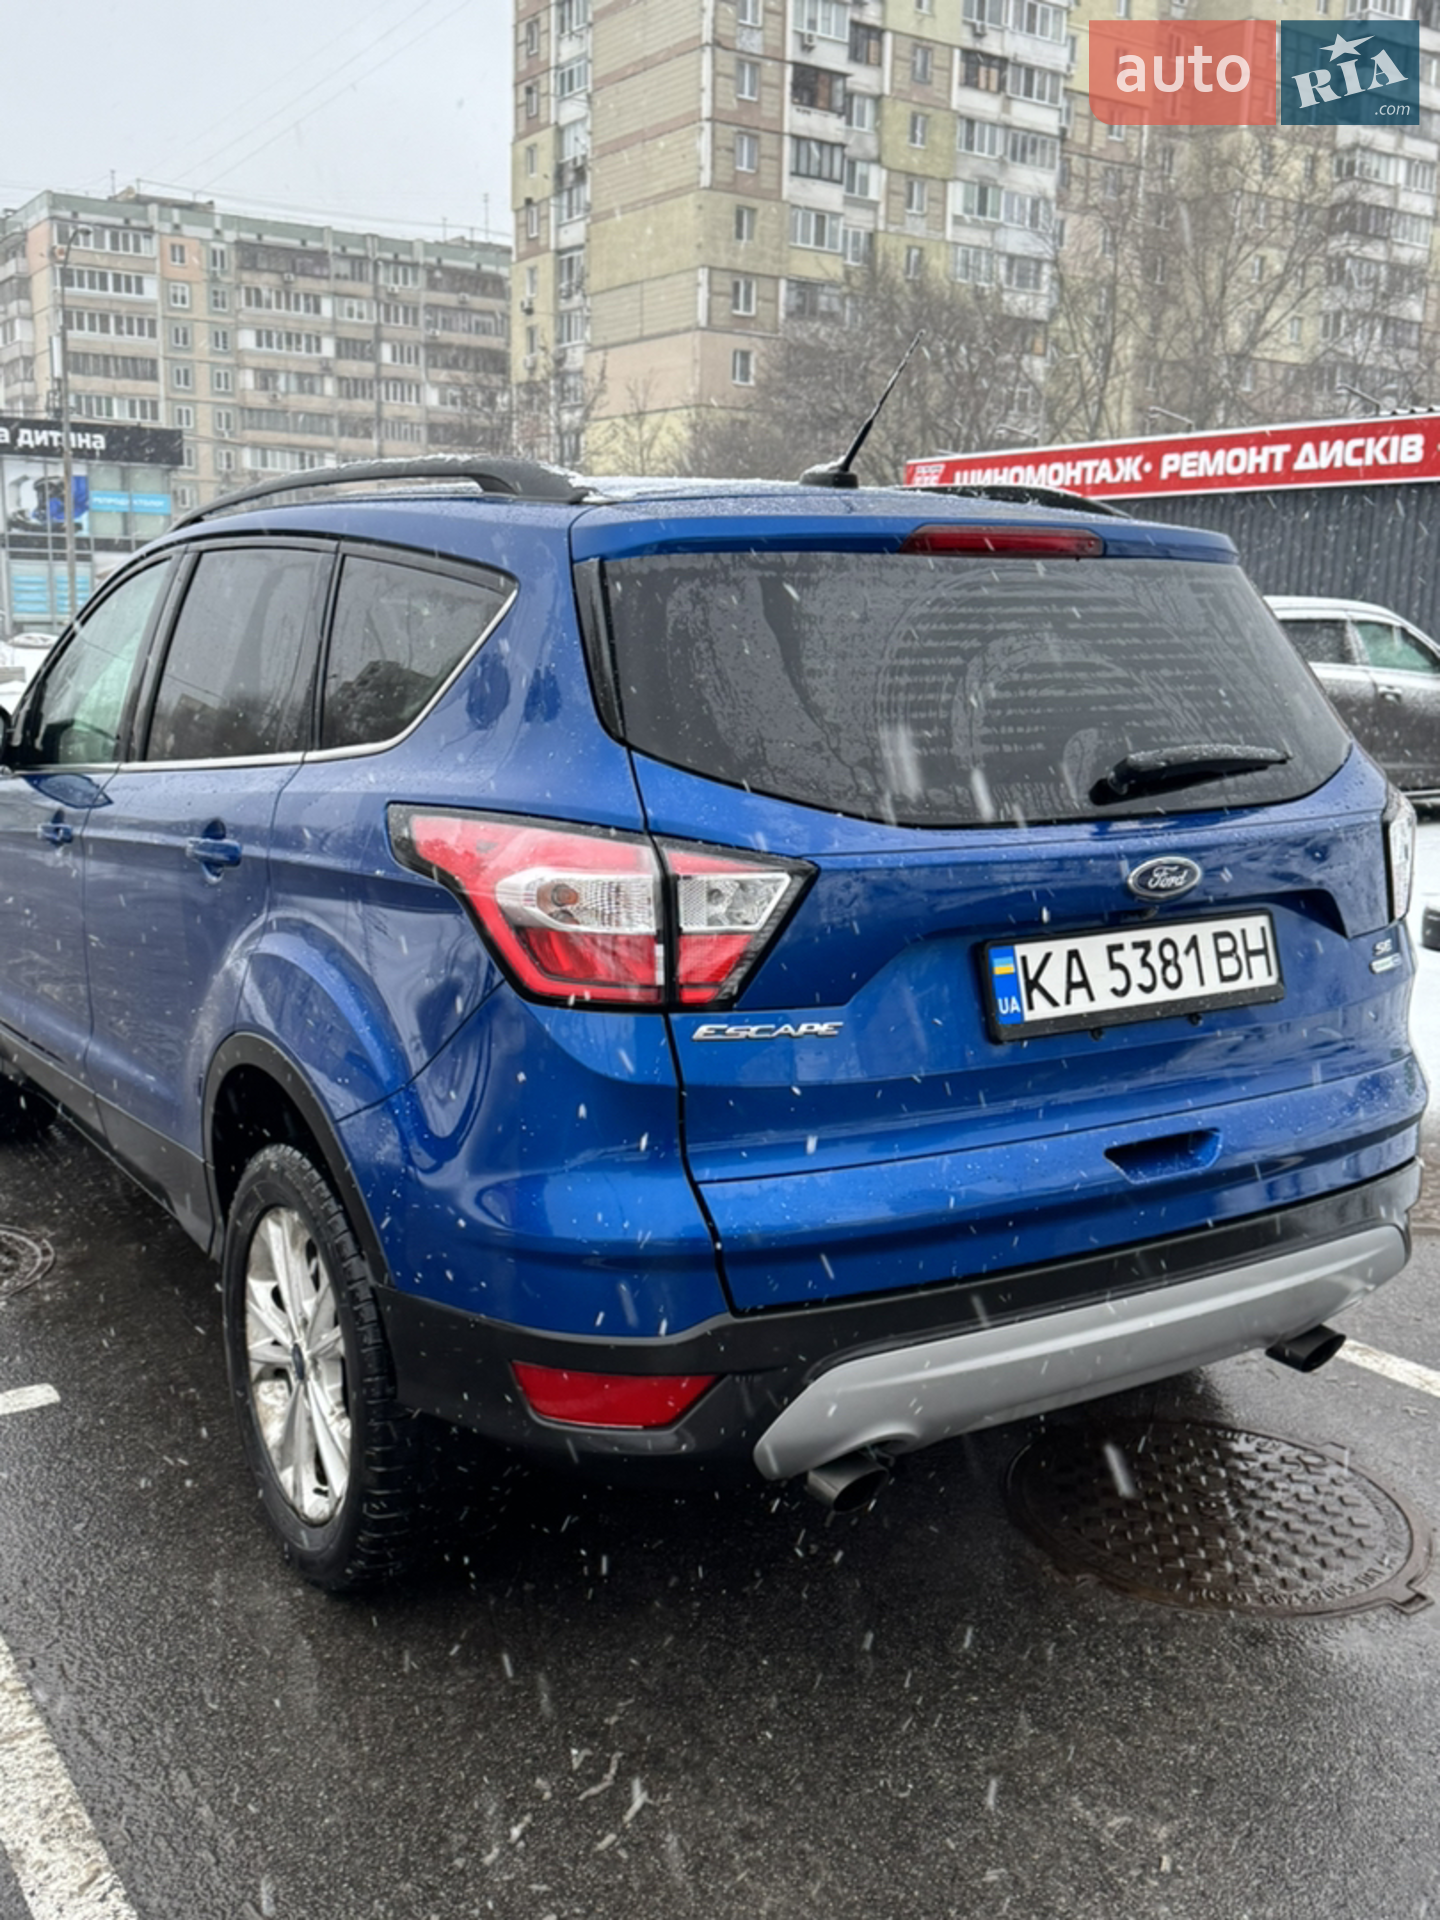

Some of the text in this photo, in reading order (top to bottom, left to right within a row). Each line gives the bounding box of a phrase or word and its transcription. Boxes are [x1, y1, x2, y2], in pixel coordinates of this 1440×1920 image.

[1160, 443, 1291, 480] РЕМОНТ
[1293, 434, 1425, 470] ДИСКІВ
[1147, 865, 1189, 889] Ford
[1020, 925, 1273, 1011] KA 5381 BH
[998, 997, 1021, 1015] UA
[692, 1021, 844, 1042] ESCAPE
